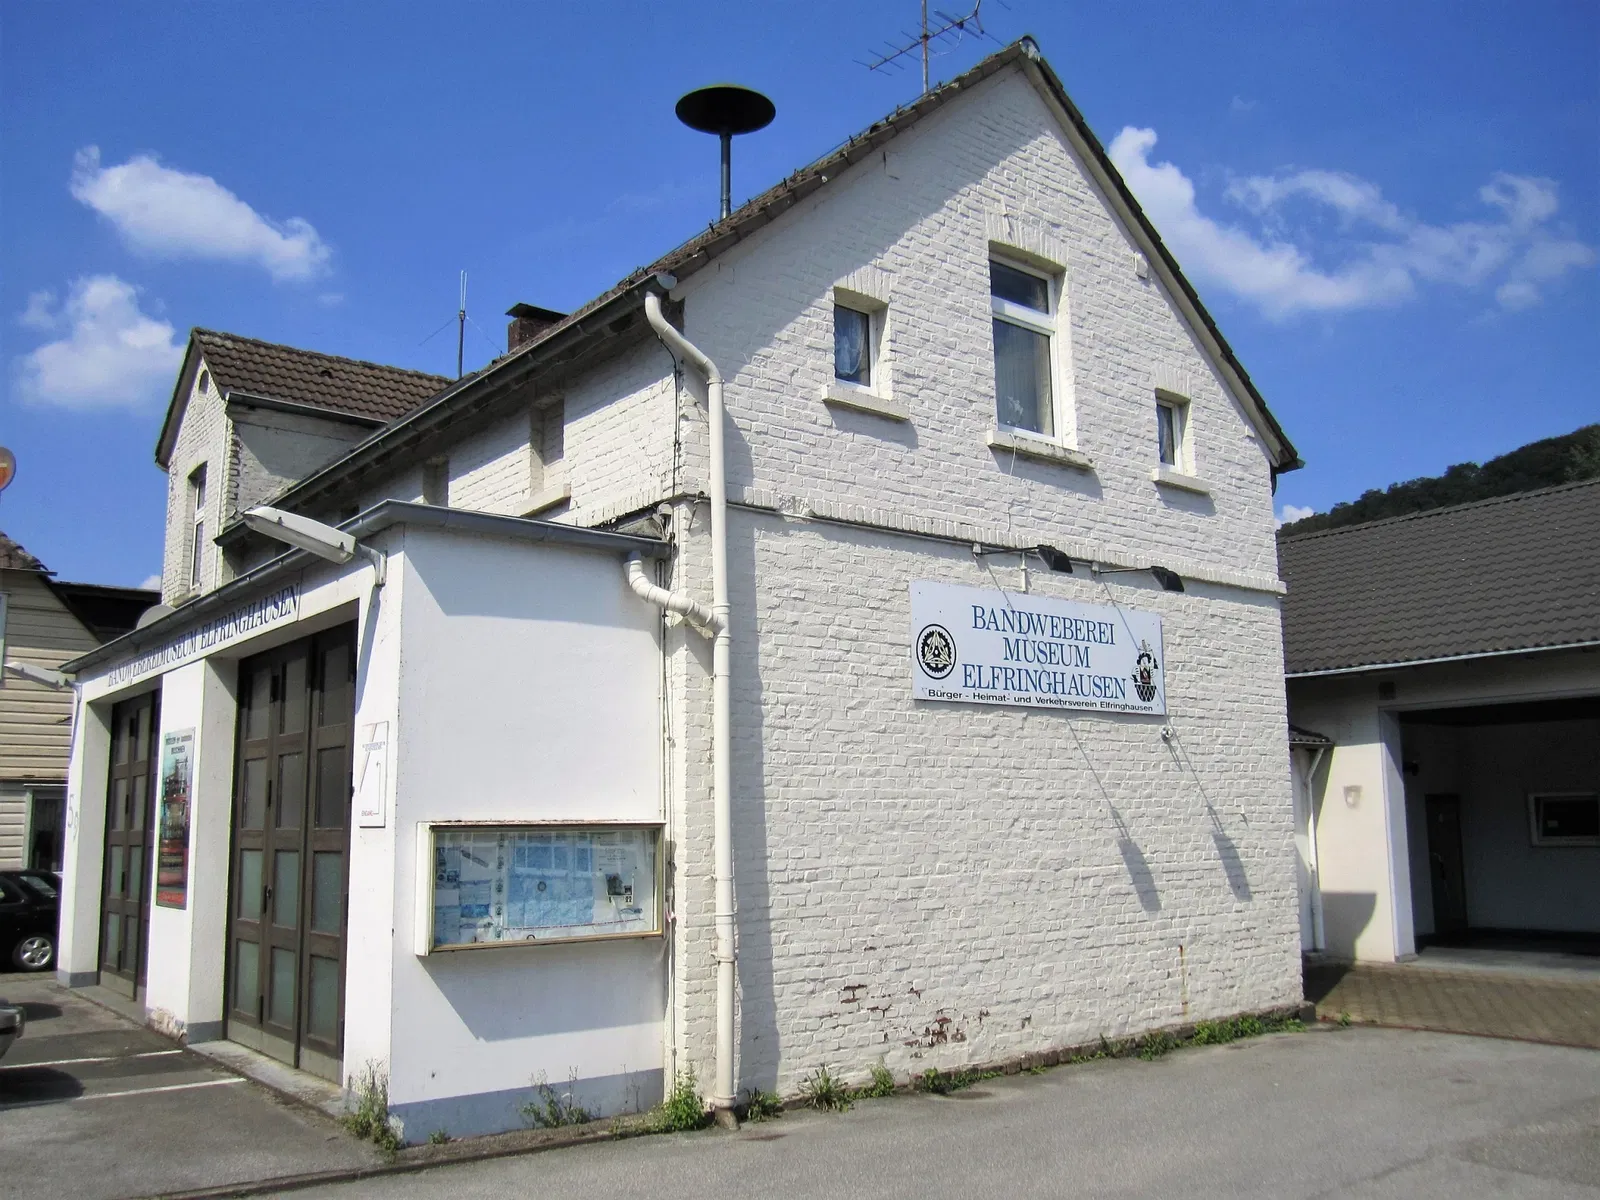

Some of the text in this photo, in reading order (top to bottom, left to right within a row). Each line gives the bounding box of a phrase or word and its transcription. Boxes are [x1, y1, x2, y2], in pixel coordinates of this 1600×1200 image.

[200, 582, 300, 650] ELFRINGHAUSEN
[971, 604, 1116, 646] BANDWEBEREI
[1002, 637, 1091, 669] MUSEUM
[928, 688, 962, 700] Bürger
[1013, 695, 1032, 704] und
[1036, 696, 1097, 708] Verkehrsverein
[1100, 700, 1153, 712] Elfringhausen
[962, 664, 1126, 700] ELFRINGHAUSEN
